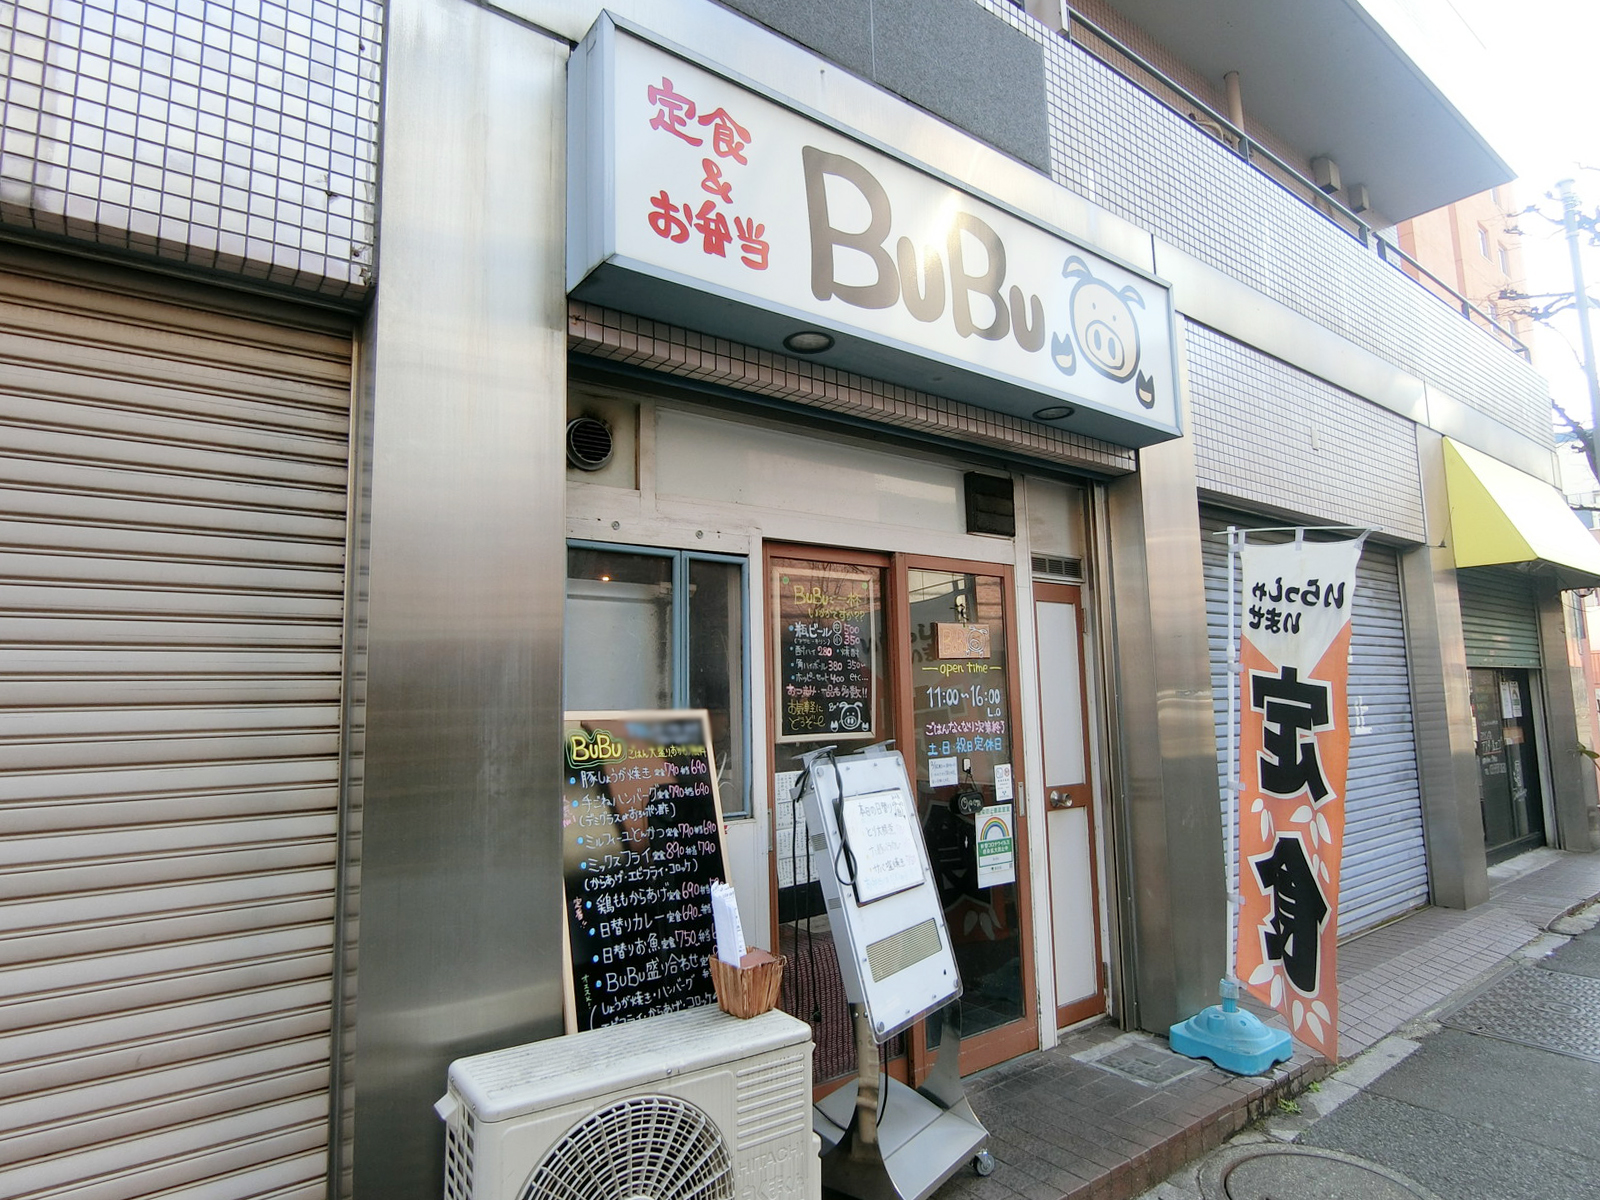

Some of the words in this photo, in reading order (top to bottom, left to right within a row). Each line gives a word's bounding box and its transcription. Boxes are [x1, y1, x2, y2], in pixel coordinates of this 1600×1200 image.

[647, 76, 752, 166] 定食
[701, 158, 734, 204] &
[648, 190, 769, 271] お弁当
[801, 145, 1046, 353] BuBu
[844, 634, 860, 645] 350
[817, 646, 833, 656] 280
[828, 660, 843, 671] 380
[940, 664, 964, 677] open
[966, 661, 988, 673] time
[926, 721, 1005, 735] ごはんなくなり次第終了
[571, 734, 622, 760] BuBu
